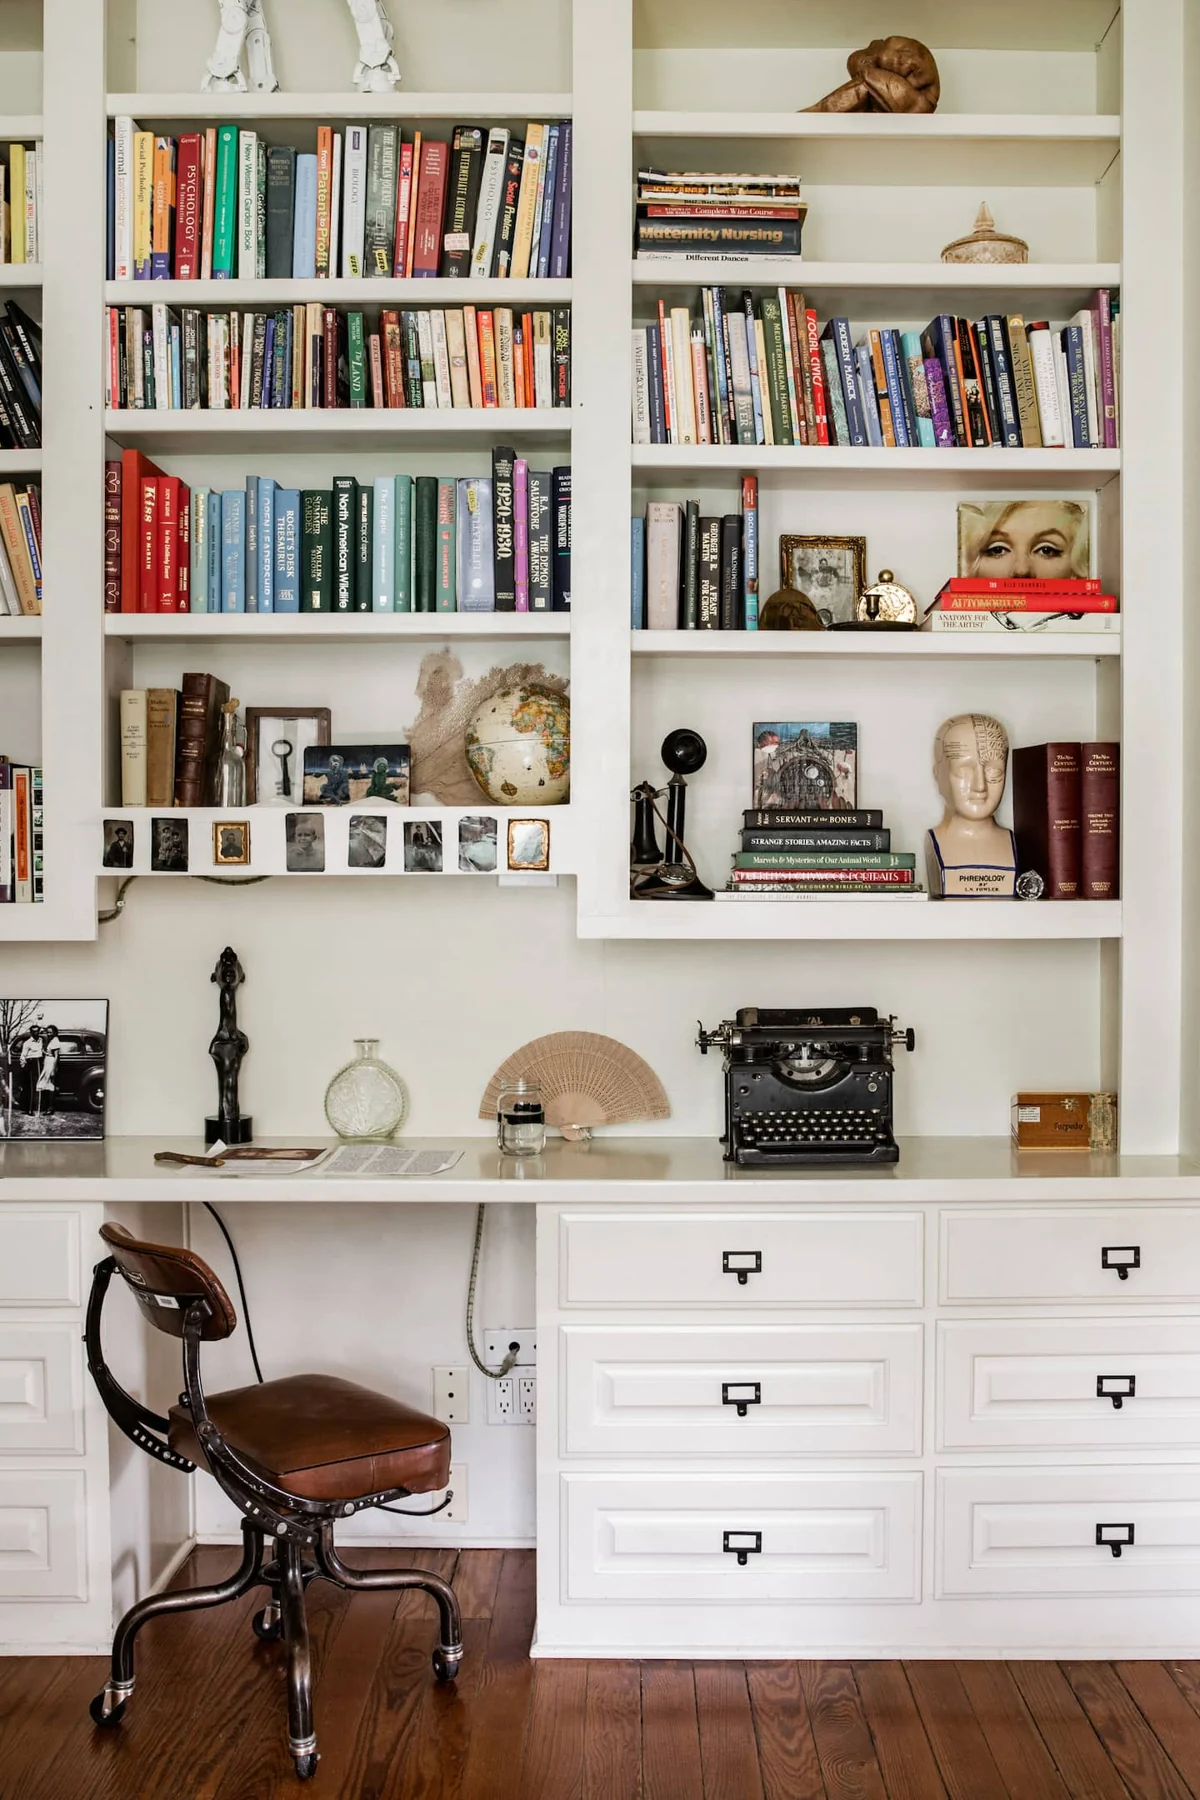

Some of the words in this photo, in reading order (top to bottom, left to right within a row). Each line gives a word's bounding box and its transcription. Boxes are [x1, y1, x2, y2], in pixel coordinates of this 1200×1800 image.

[383, 132, 394, 146] THE
[382, 147, 393, 178] AMERICAN
[458, 152, 471, 194] INTERMEDIATE
[138, 162, 146, 202] Psychology
[318, 170, 328, 216] Patent
[380, 178, 392, 206] JOURNEY
[484, 161, 500, 222] PSYCHOLOGY
[506, 181, 518, 204] Social
[186, 165, 196, 240] PSYCHOLOGY
[244, 198, 252, 228] Garden
[420, 191, 428, 224] POWER
[432, 188, 440, 224] LIBERTY
[454, 197, 466, 232] ACCOUNTING
[320, 218, 326, 227] to
[502, 206, 516, 240] Problems
[640, 227, 720, 241] Maternity
[722, 228, 783, 242] Nursing
[317, 228, 328, 268] Profit
[350, 255, 358, 274] USED
[377, 252, 386, 270] USED
[476, 245, 486, 261] USED
[807, 316, 818, 353] SOCIAL
[992, 330, 1003, 351] MILLMAN
[636, 346, 644, 373] WHITE
[773, 323, 788, 390] MEDITERRANEAN
[811, 357, 822, 387] CIVICS
[838, 322, 849, 361] MODERN
[844, 365, 856, 400] MAGICK
[1107, 367, 1111, 377] OF
[352, 360, 362, 391] LAND
[1000, 373, 1009, 392] EVERYDAY
[1021, 358, 1034, 408] AMERICAN
[636, 380, 644, 422] OLEANDER
[780, 393, 789, 429] HARVEST
[1002, 394, 1014, 424] ENLIGHTENMENT
[1014, 368, 1027, 424] LANGUAGE
[740, 401, 748, 426] DYER
[144, 485, 156, 523] Kiss
[313, 496, 322, 535] SUMMER
[339, 493, 349, 520] North
[440, 485, 448, 524] HARRIS
[531, 480, 539, 530] SALVATORE
[146, 532, 151, 541] ED
[286, 510, 294, 550] ROGET'S
[558, 505, 566, 548] WORDFINDER
[277, 517, 285, 571] THESAURUS
[339, 522, 348, 571] American
[540, 535, 548, 553] THE
[286, 554, 294, 578] DESK
[531, 540, 539, 583] AWAKENS
[540, 556, 548, 588] DEMON
[339, 573, 349, 608] Wildlife
[753, 856, 778, 864] Marvels
[786, 857, 815, 866] Mysteries
[1054, 1123, 1083, 1131] Torpedo
